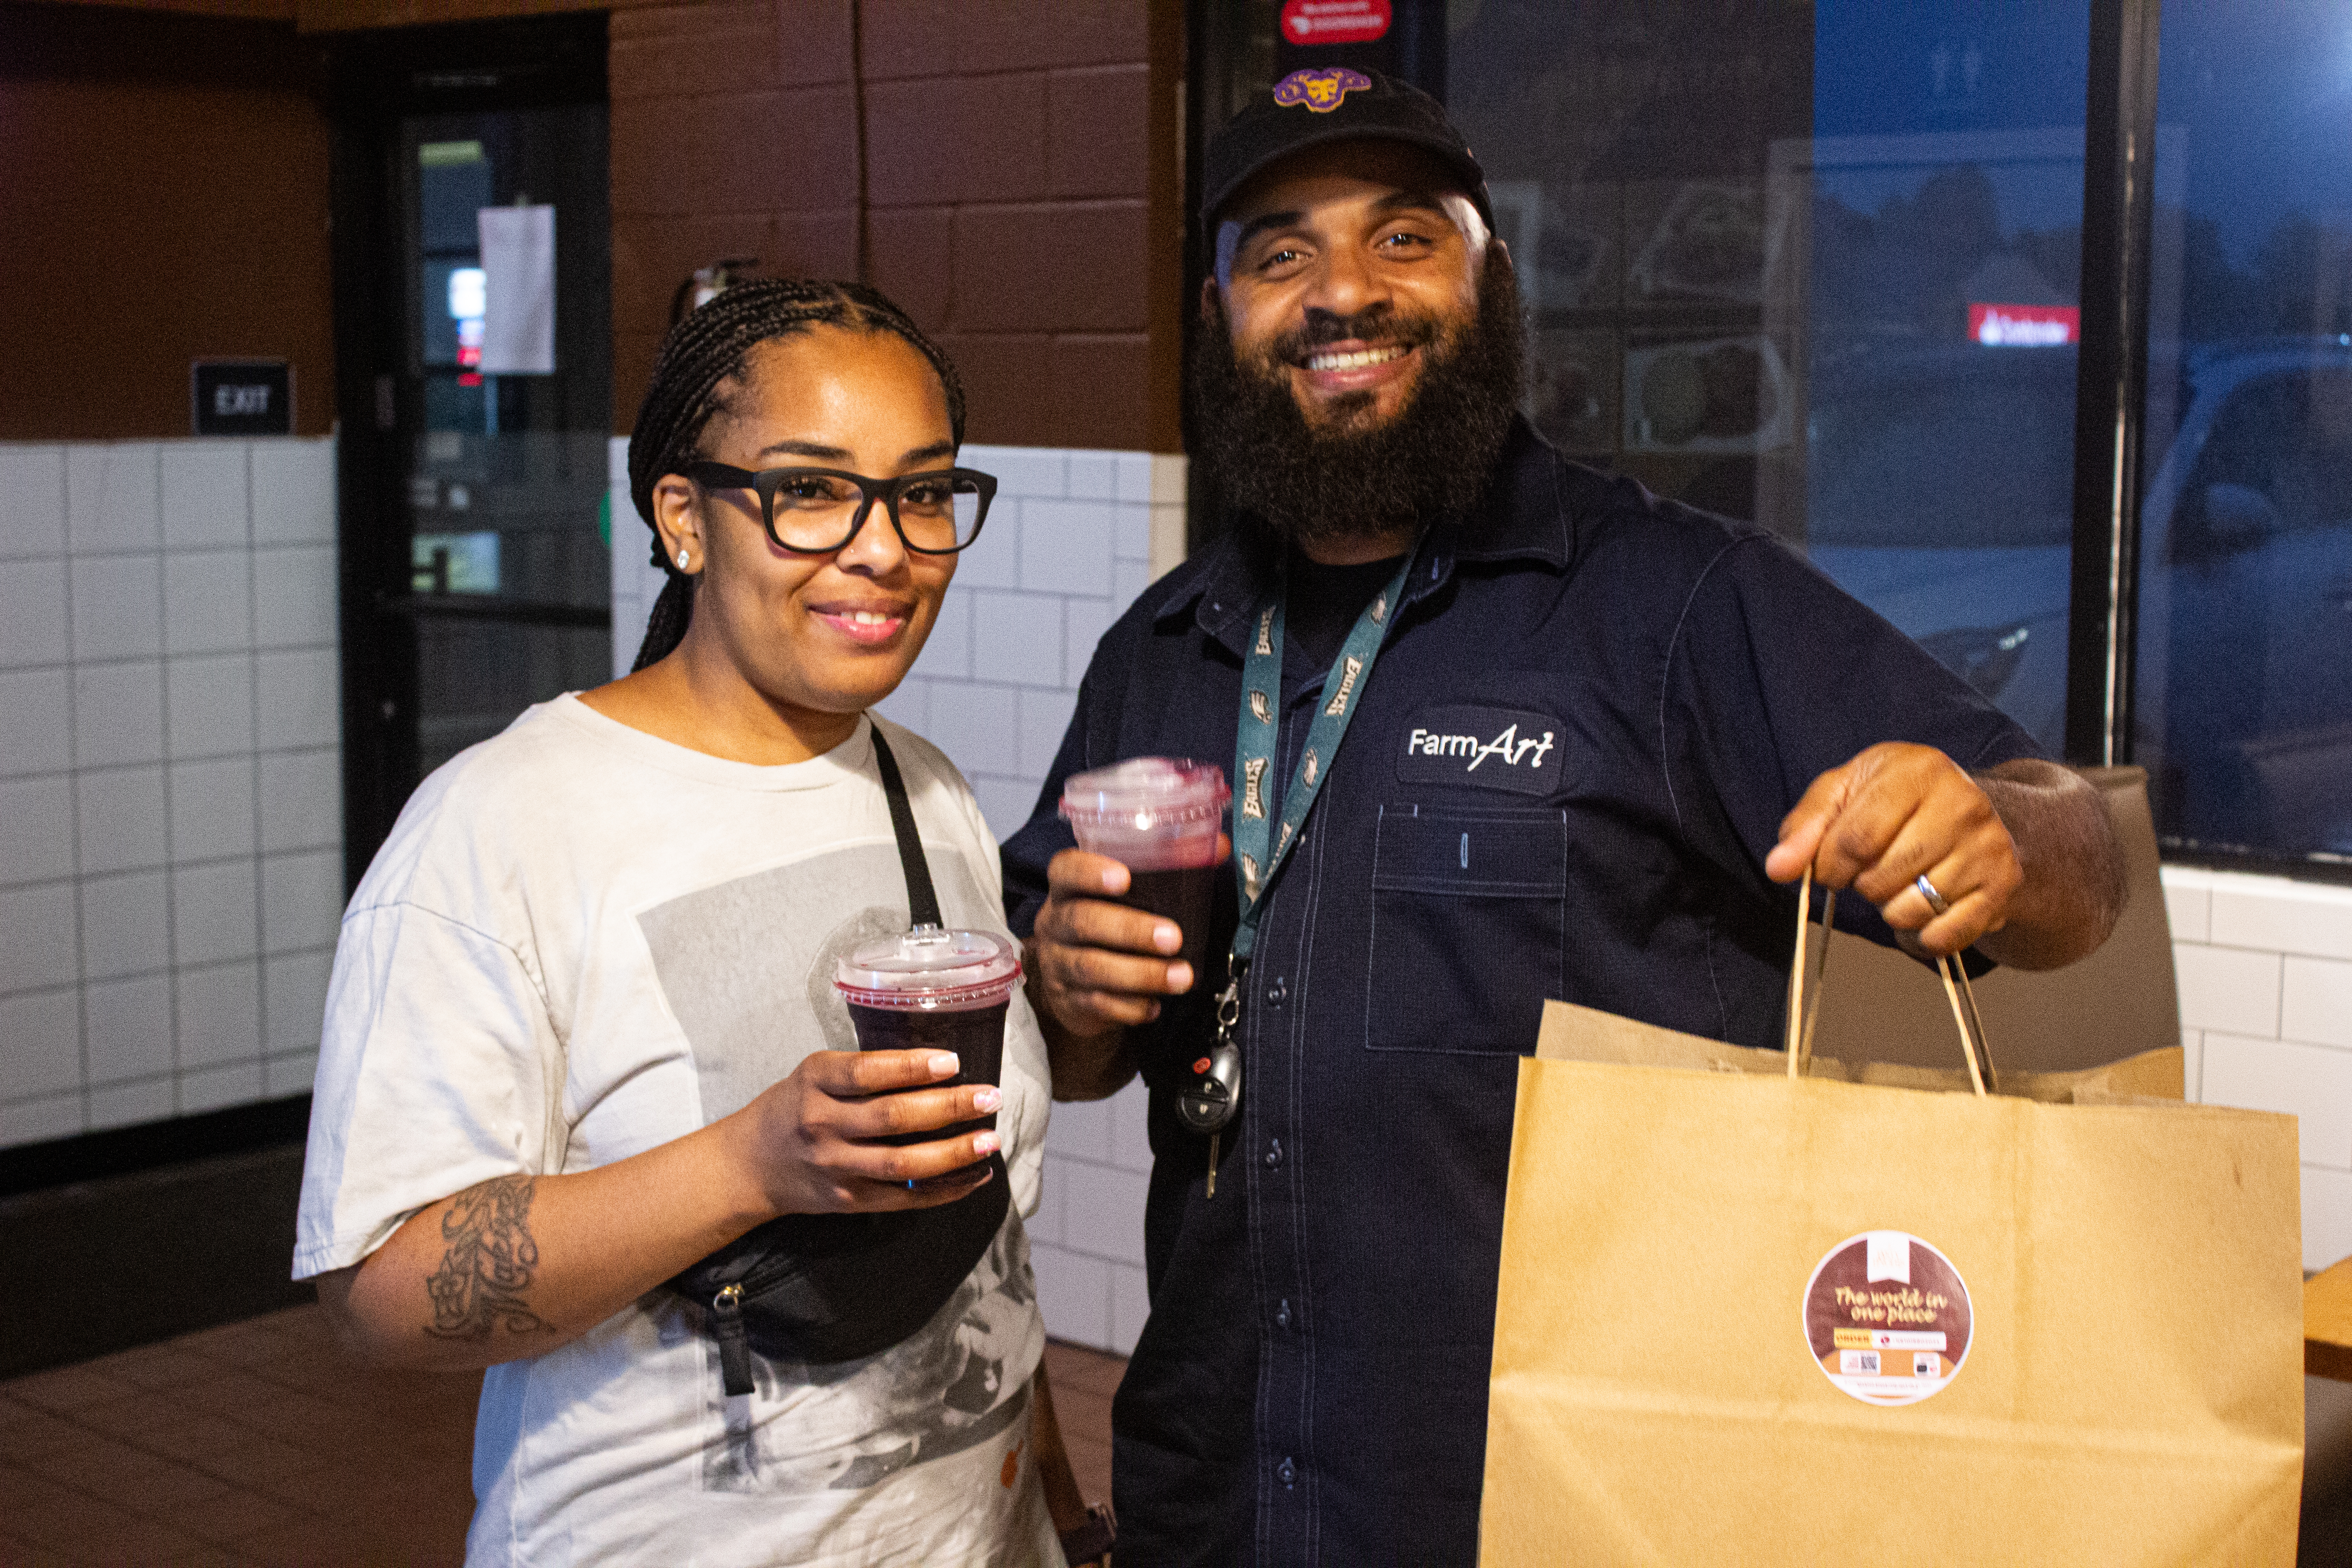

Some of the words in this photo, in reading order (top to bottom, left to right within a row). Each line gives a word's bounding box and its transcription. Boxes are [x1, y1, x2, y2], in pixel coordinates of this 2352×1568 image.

[216, 385, 271, 415] EXIT
[1325, 657, 1362, 716] EAGLES
[1242, 757, 1268, 818] EAGLES
[1835, 1286, 1869, 1305] The
[1871, 1288, 1923, 1307] world
[1926, 1291, 1948, 1309] in
[1851, 1306, 1886, 1321] one
[1886, 1303, 1937, 1327] place
